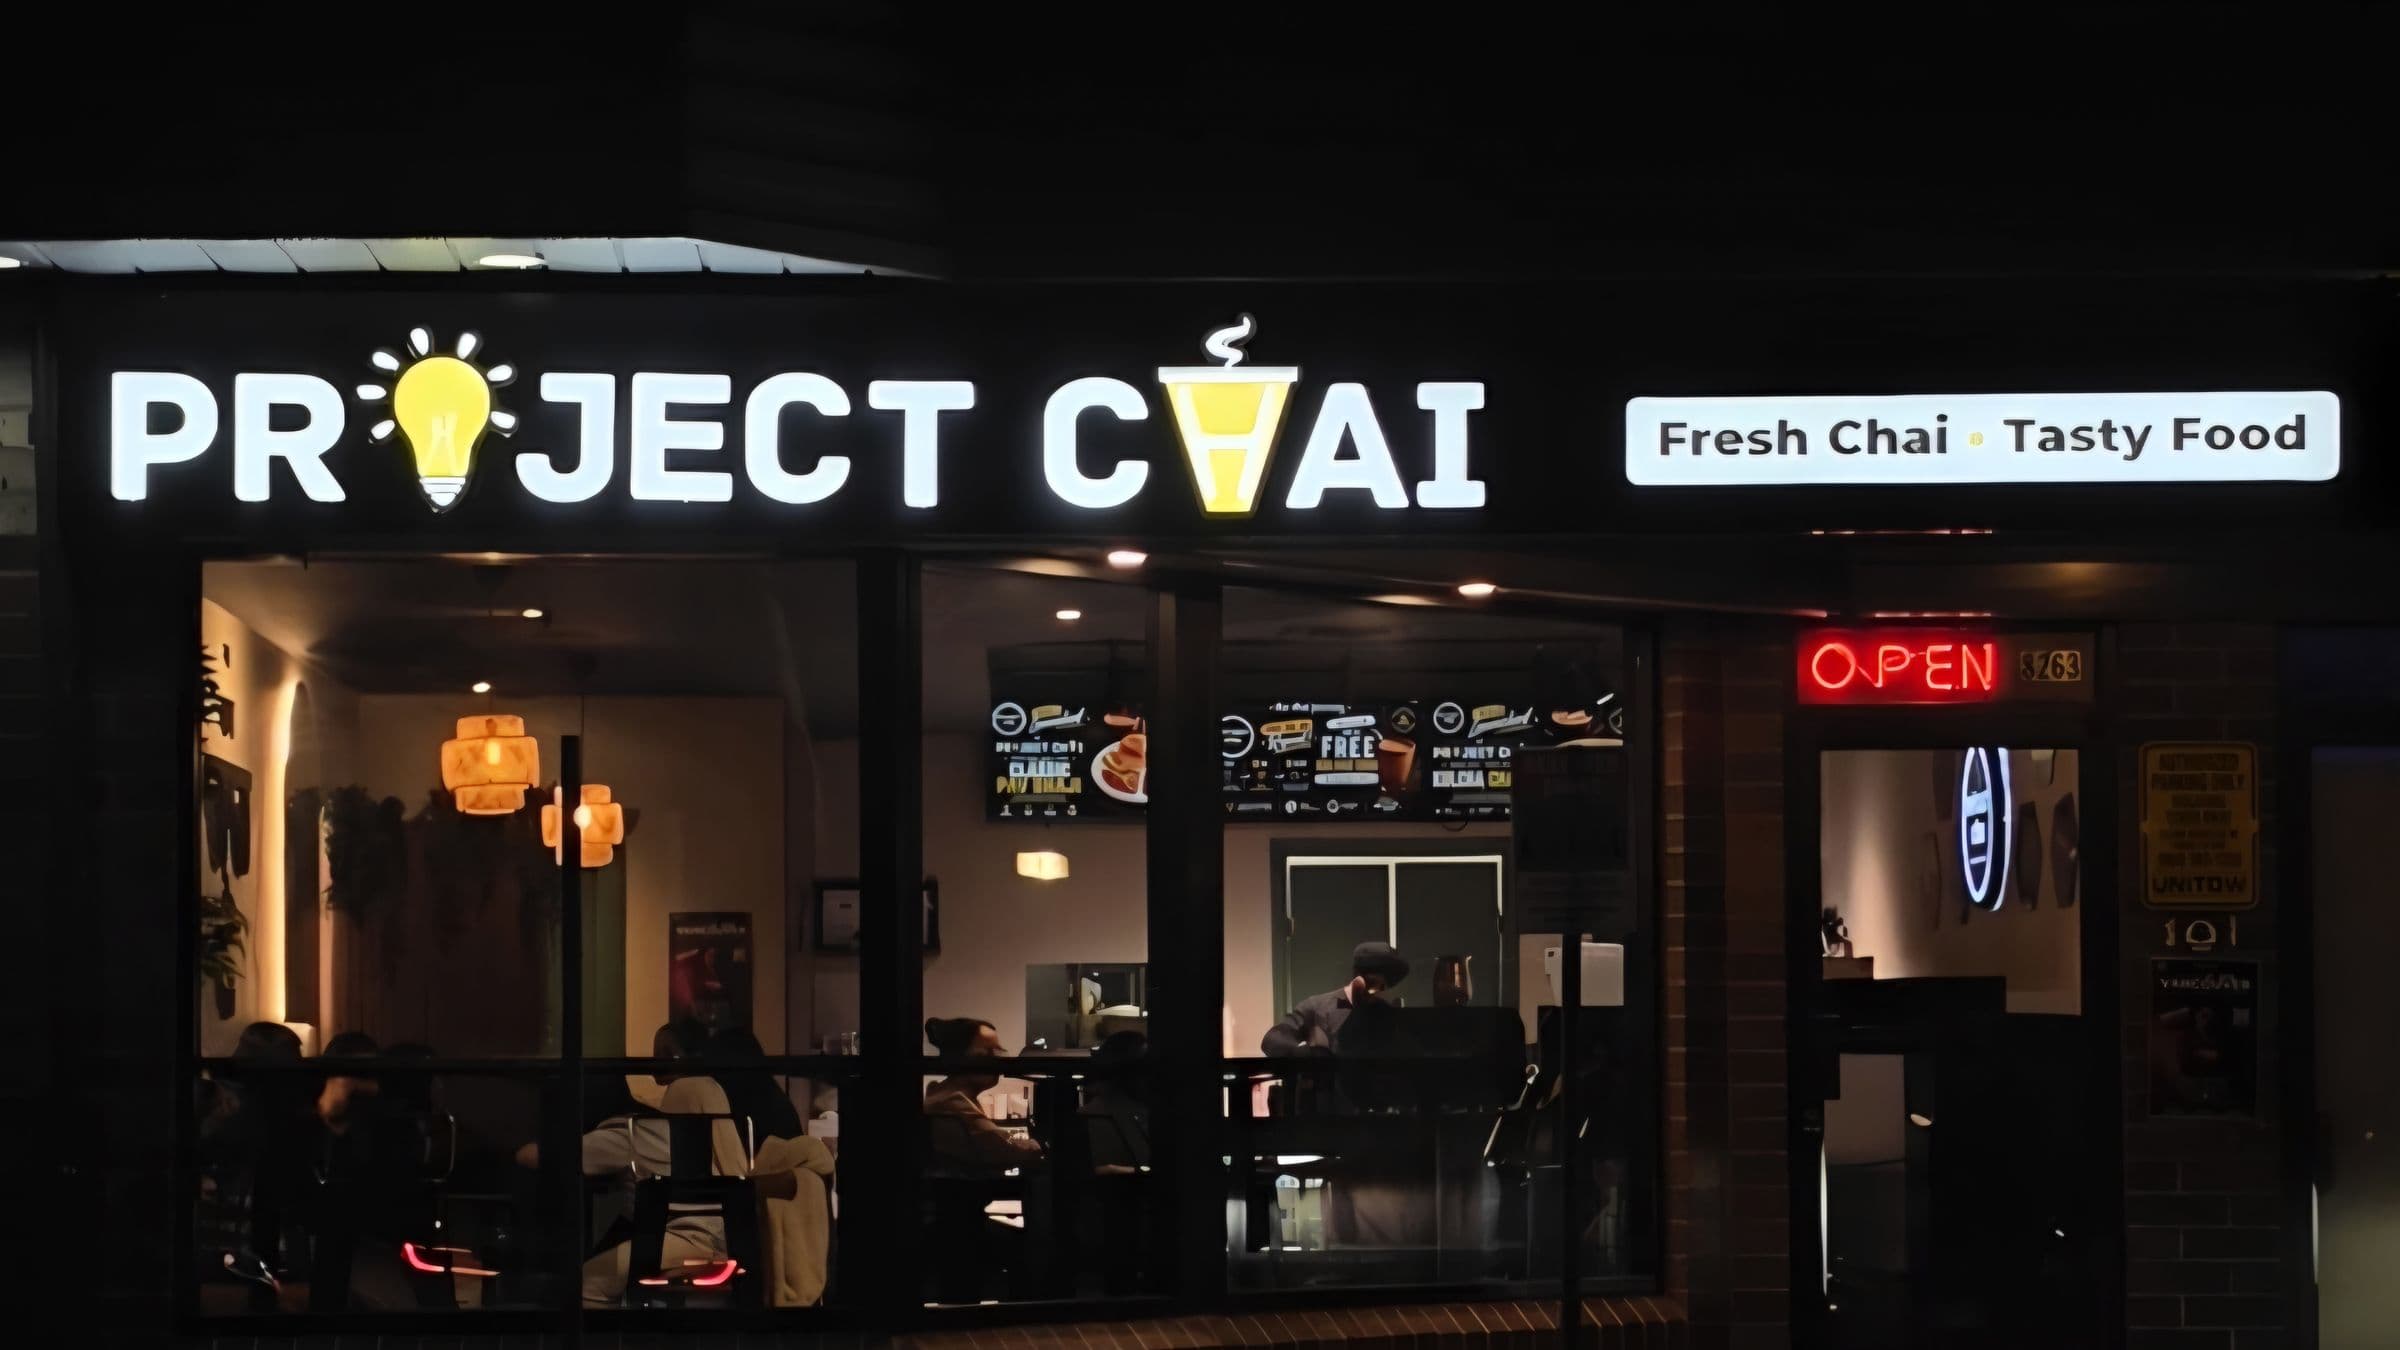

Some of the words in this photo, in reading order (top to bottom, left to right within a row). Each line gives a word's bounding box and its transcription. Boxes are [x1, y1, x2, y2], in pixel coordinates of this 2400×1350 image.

[1043, 366, 1486, 513] CHAI
[1659, 419, 1807, 456] Fresh
[1828, 414, 1949, 456] Chai
[2003, 418, 2152, 461] Tasty
[2173, 414, 2306, 452] Food
[1812, 642, 1993, 690] OPEN
[1321, 735, 1375, 758] FREE
